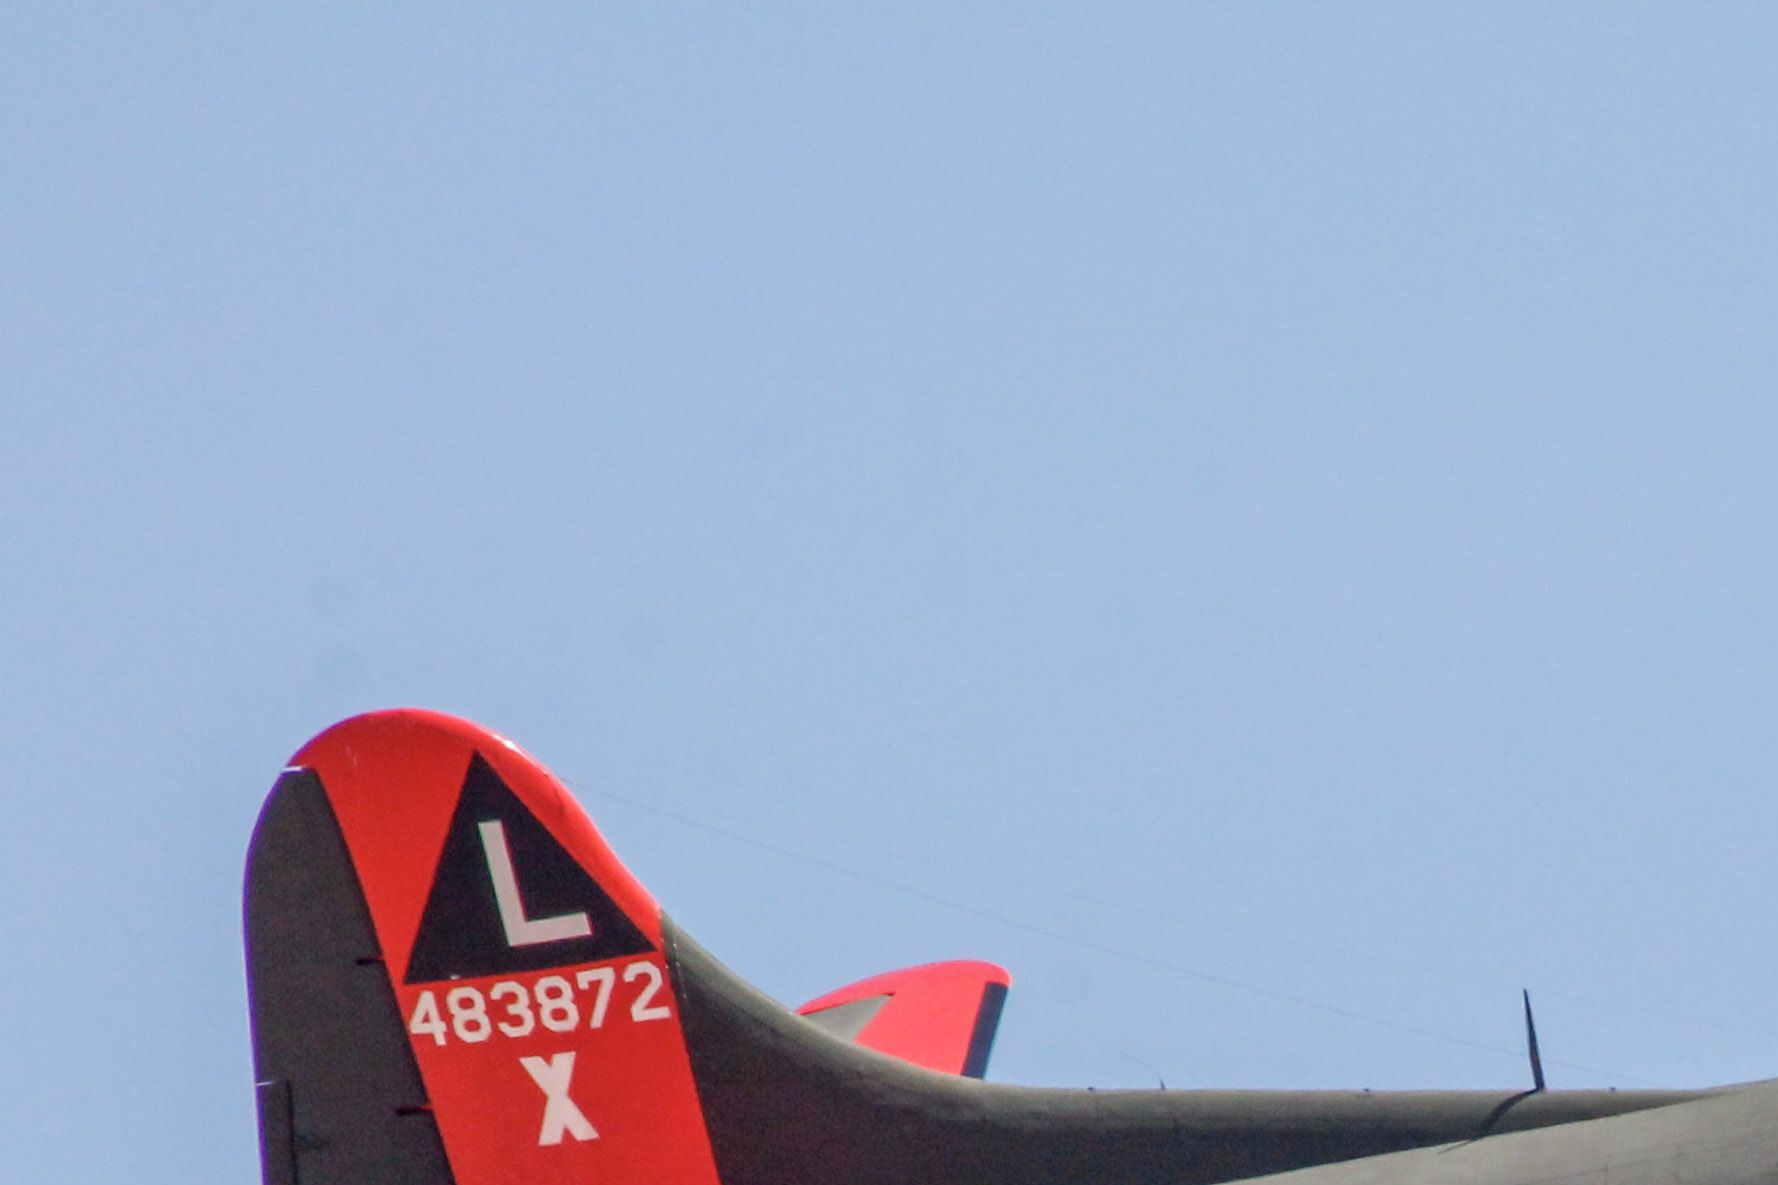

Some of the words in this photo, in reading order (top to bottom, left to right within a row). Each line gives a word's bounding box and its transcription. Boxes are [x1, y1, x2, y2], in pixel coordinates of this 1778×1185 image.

[478, 819, 592, 947] L
[408, 961, 671, 1046] 483872
[519, 1051, 599, 1147] X
